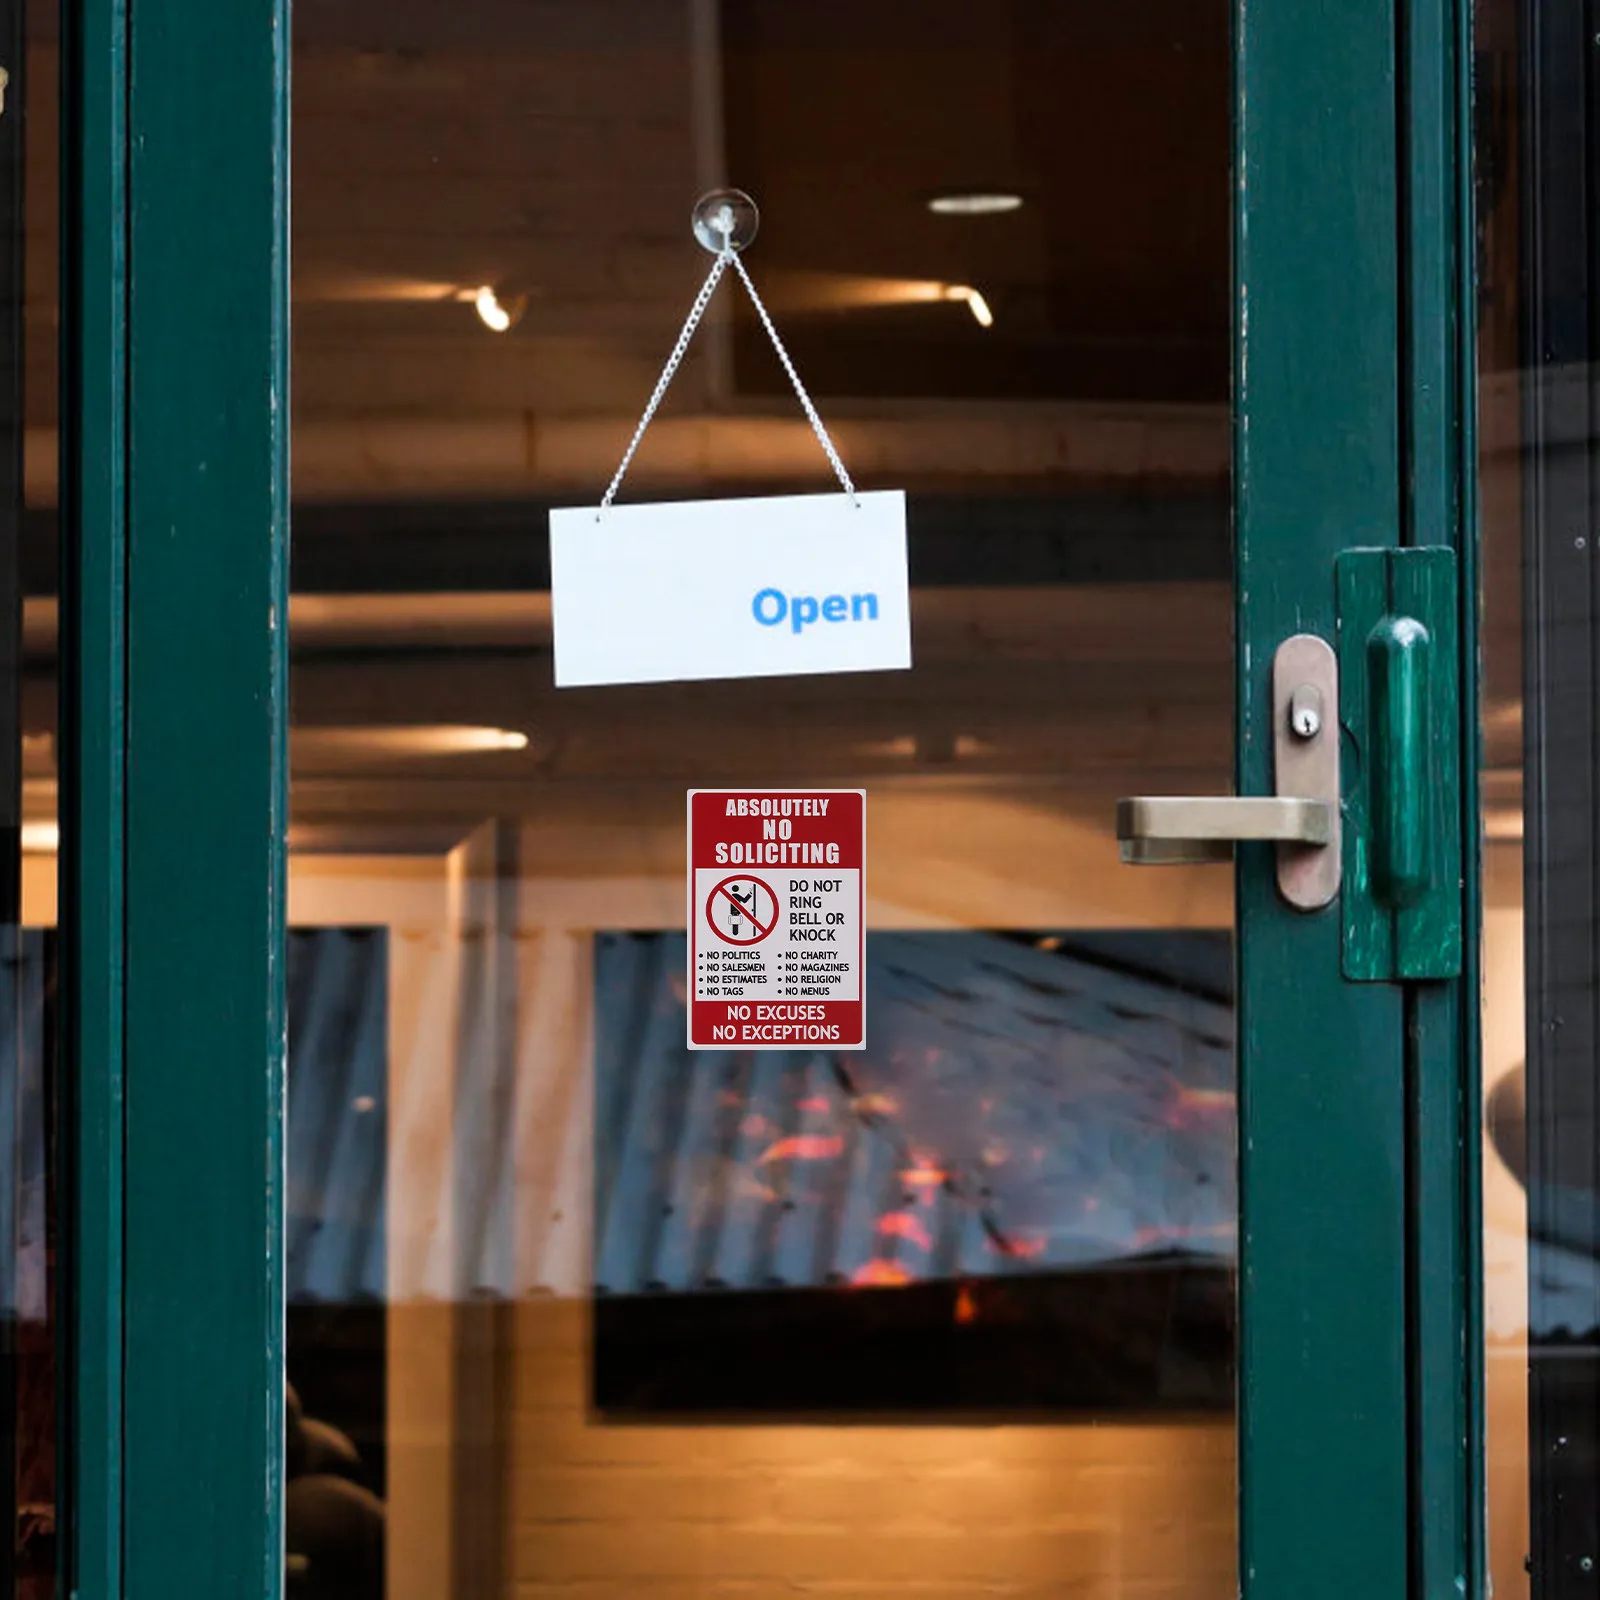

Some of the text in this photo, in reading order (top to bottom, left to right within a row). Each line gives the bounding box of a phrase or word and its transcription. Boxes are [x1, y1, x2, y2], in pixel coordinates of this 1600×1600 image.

[752, 587, 879, 634] Open
[725, 799, 830, 816] ABSOLUTELY
[763, 819, 792, 840] NO
[715, 843, 840, 864] SOLICITING
[789, 880, 842, 892] DO NOT
[789, 896, 822, 908] RING
[789, 913, 845, 925] BELL OR
[789, 929, 836, 941] KNOCK
[706, 951, 761, 960] NO POLITICS
[785, 951, 838, 960] NO CHARITY
[706, 963, 765, 972] NO SALESMEN
[785, 963, 849, 972] NO MAGAZINES
[706, 975, 767, 984] NO ESTIMATES
[785, 975, 841, 984] NO RELIGION
[706, 987, 744, 996] NO TAGS
[785, 987, 830, 996] NO MENUS
[727, 1005, 826, 1020] NO EXCUSES
[713, 1025, 840, 1040] NO EXCEPTIONS
